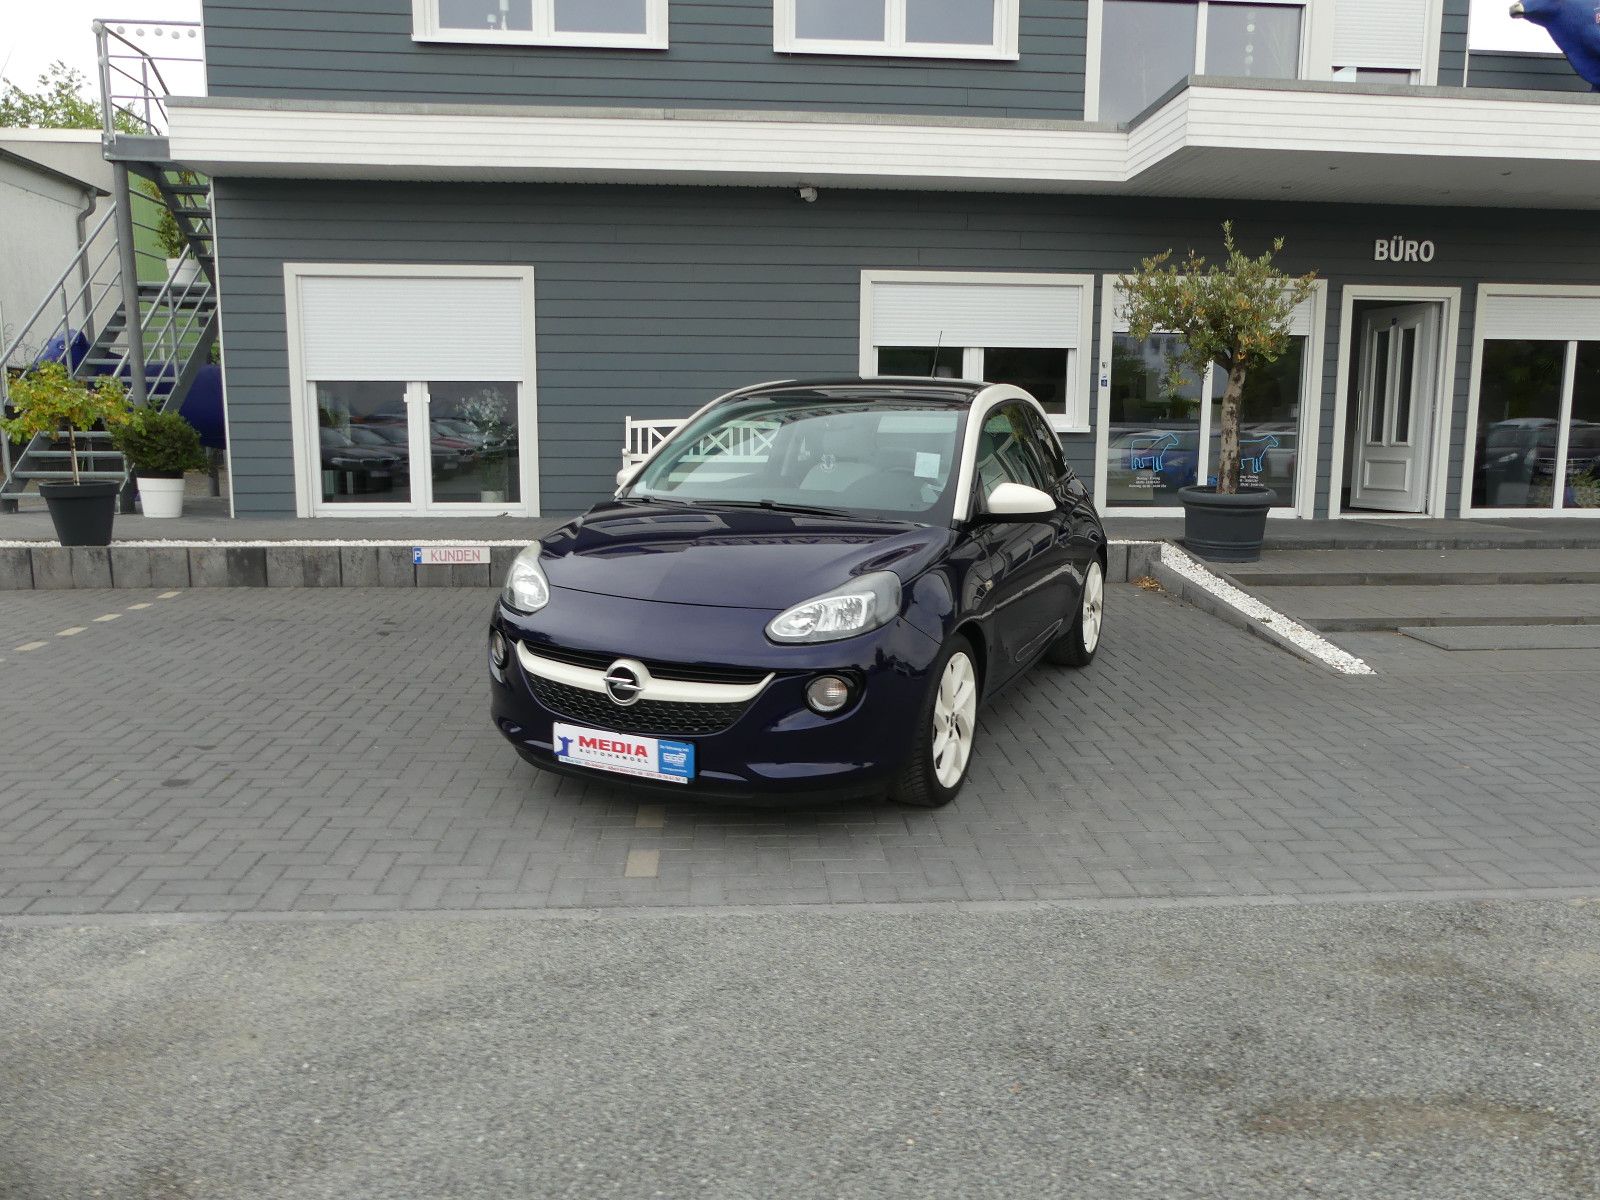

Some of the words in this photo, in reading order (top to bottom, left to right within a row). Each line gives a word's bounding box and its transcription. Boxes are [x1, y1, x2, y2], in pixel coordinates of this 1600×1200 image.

[1374, 235, 1435, 263] BÜRO
[414, 550, 422, 561] P
[430, 549, 481, 562] KUNDEN
[578, 735, 648, 758] MEDIA
[579, 748, 649, 764] AUTOHANDEL
